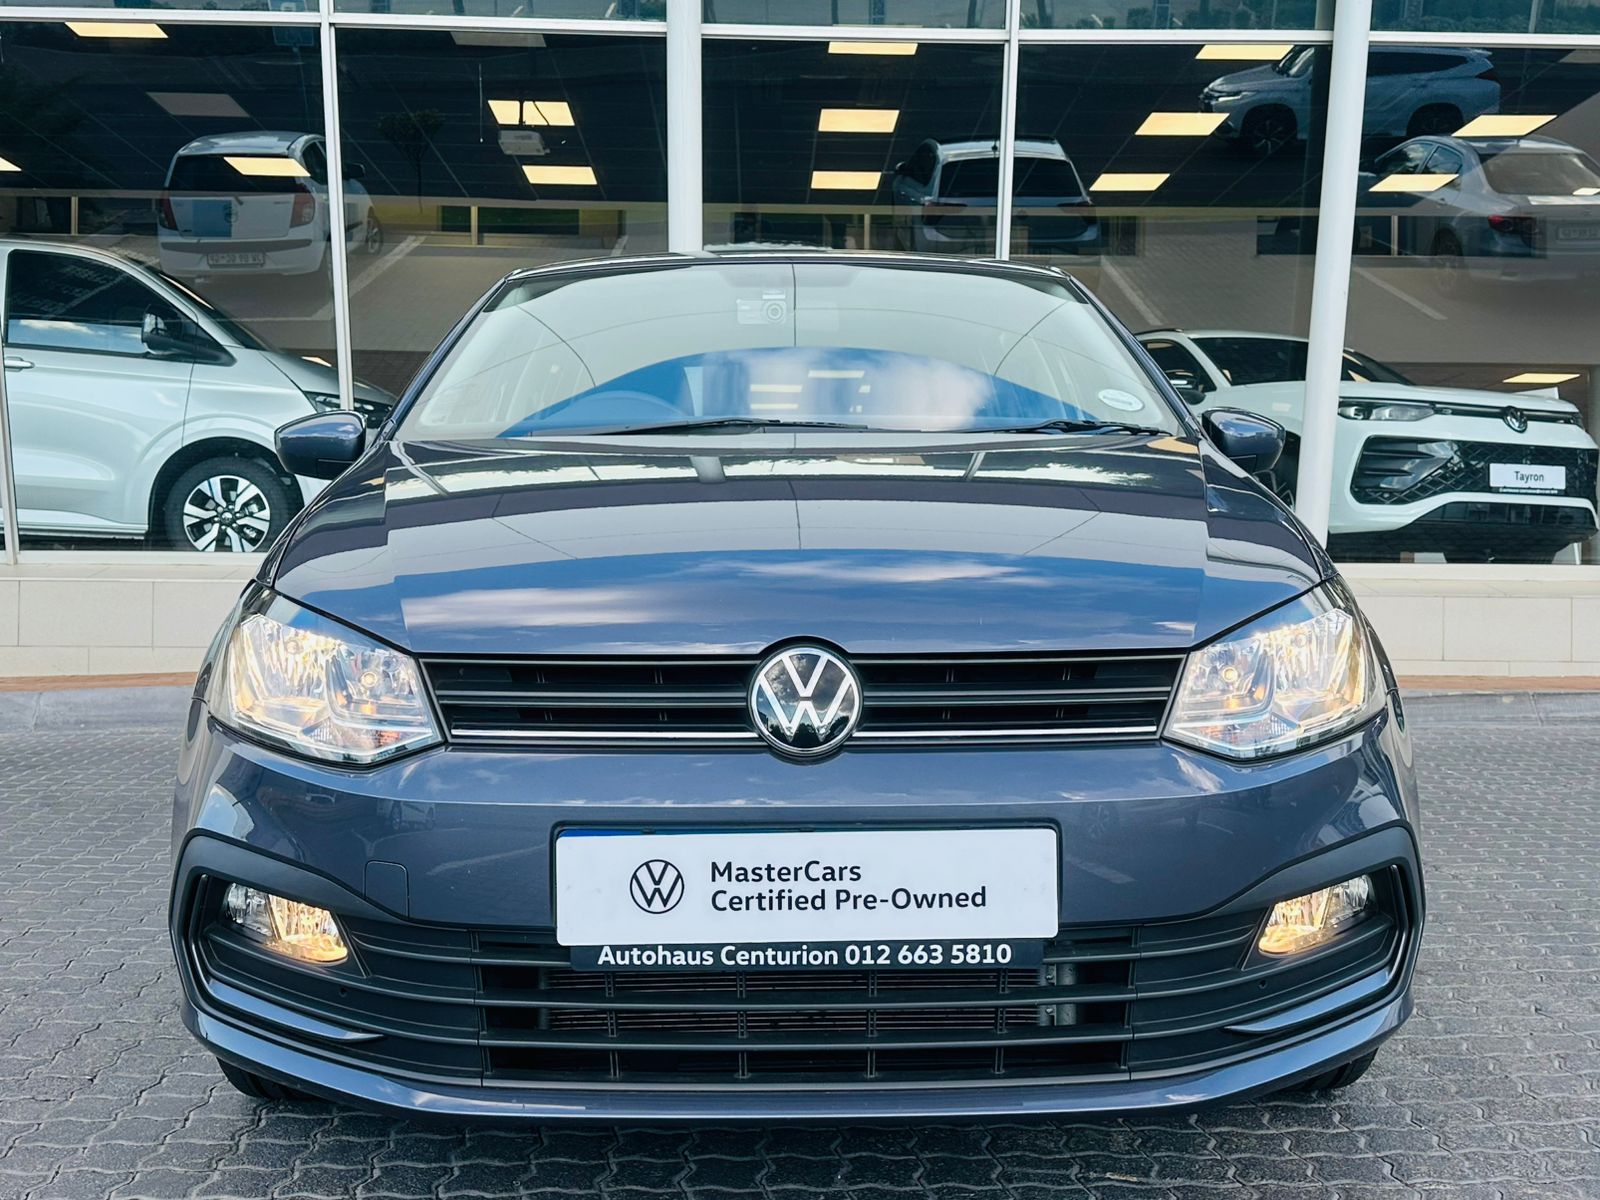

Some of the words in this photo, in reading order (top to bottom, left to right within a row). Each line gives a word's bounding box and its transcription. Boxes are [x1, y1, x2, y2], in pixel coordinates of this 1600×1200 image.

[1514, 470, 1544, 484] Tayron
[751, 647, 860, 753] VW
[711, 861, 862, 883] MasterCars
[630, 859, 684, 914] VW
[711, 889, 826, 912] Certified
[835, 886, 987, 911] Pre-Owned
[597, 945, 714, 966] Autohaus
[720, 945, 839, 966] Centurion
[844, 944, 891, 965] 012
[897, 944, 944, 965] 663
[950, 943, 1012, 965] 5810
